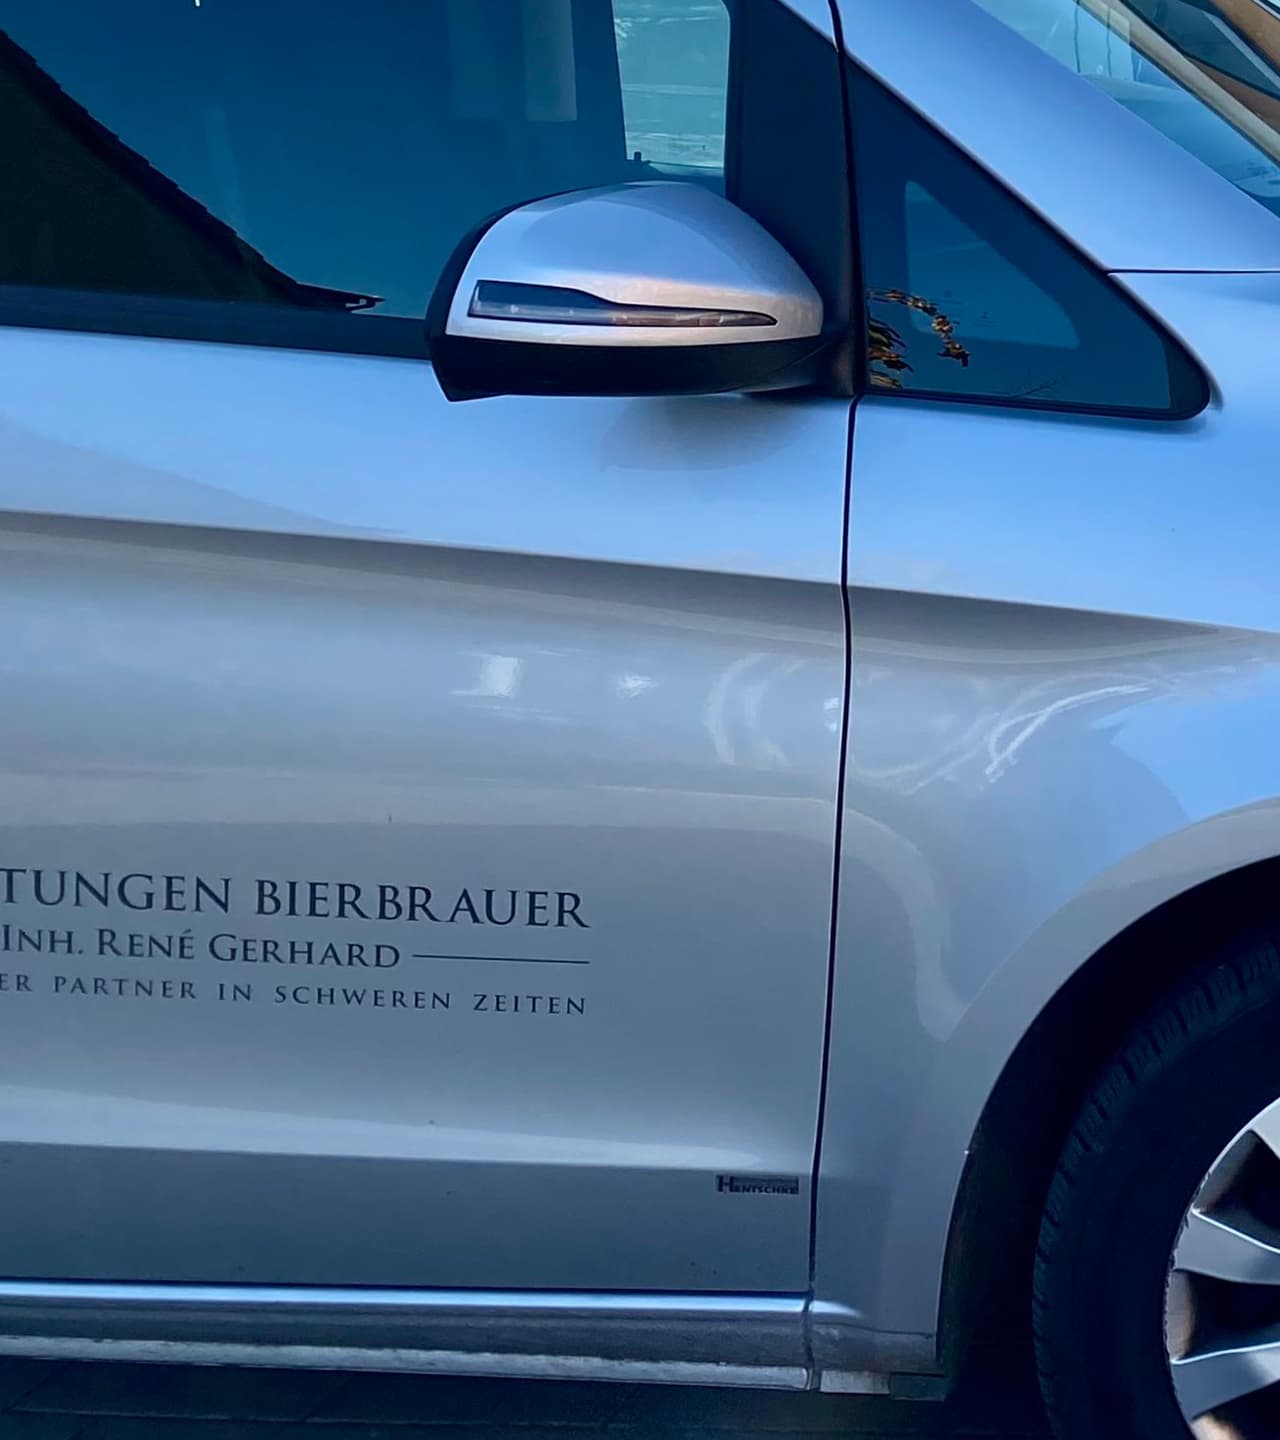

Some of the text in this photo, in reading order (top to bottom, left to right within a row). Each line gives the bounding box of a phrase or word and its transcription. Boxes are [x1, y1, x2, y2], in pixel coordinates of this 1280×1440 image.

[0, 868, 591, 928] TUNGEN BIERBRAUER
[54, 975, 197, 999] PARTNER
[218, 983, 252, 1001] IN
[274, 985, 450, 1009] SCHWEREN
[473, 993, 585, 1015] ZEITEN
